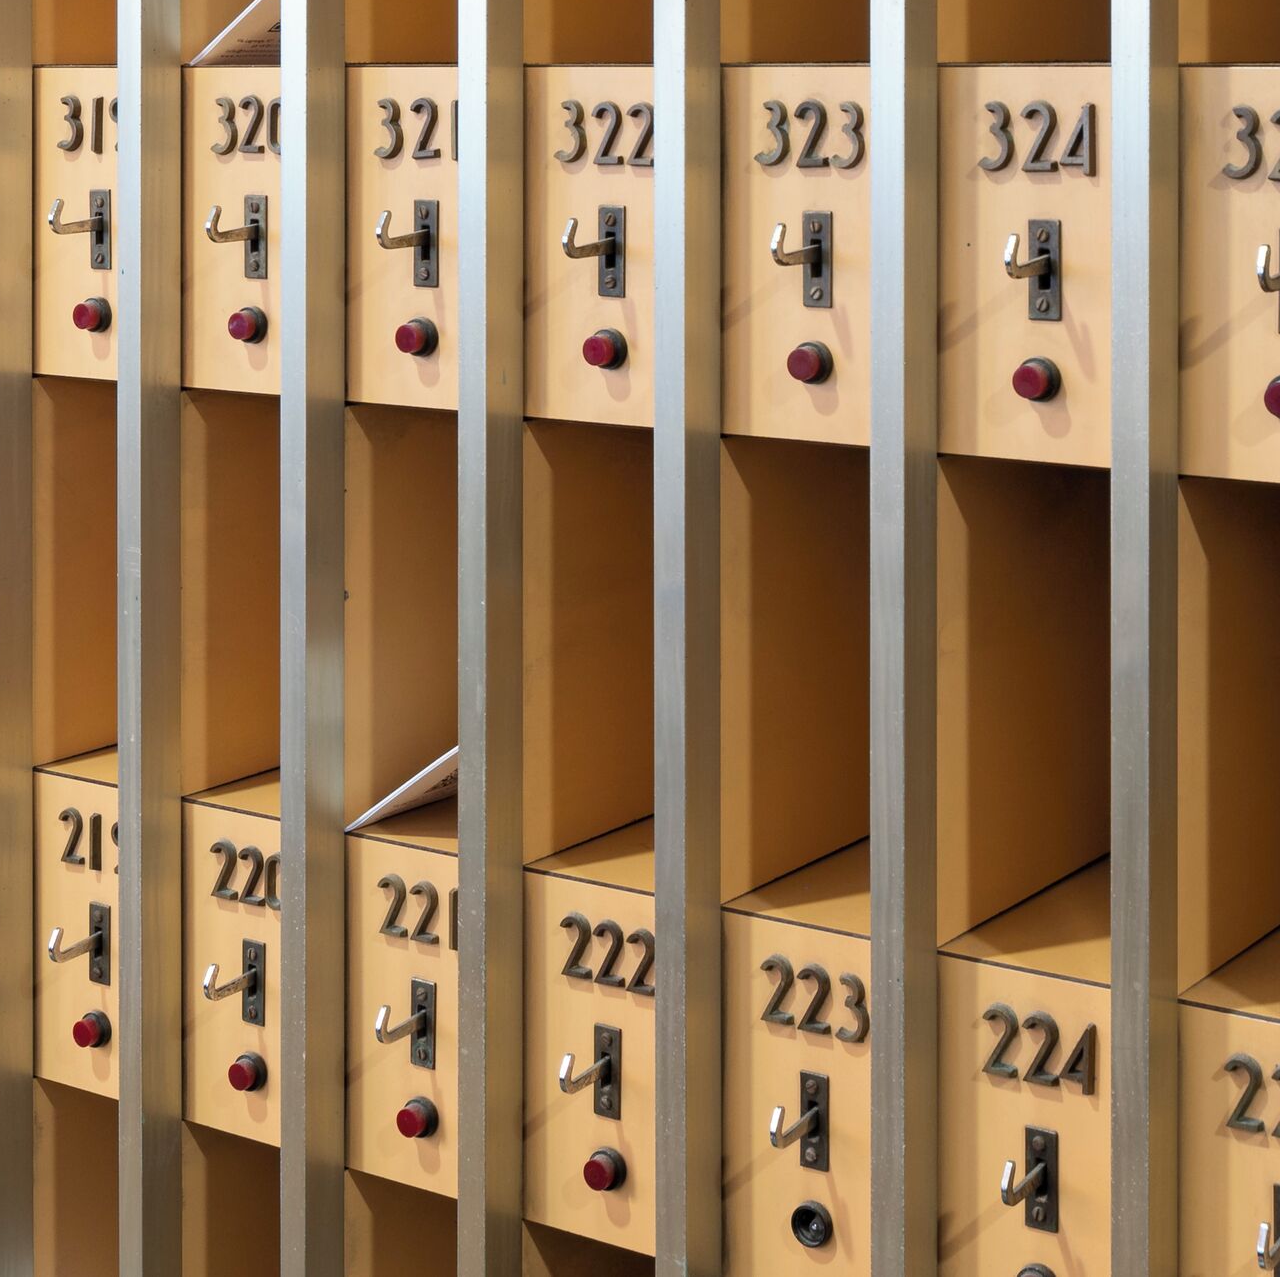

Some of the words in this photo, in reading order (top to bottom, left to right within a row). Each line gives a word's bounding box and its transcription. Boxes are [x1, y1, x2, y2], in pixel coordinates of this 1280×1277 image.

[553, 99, 654, 165] 322
[754, 99, 865, 170] 323
[978, 100, 1096, 177] 324
[560, 911, 655, 996] 222
[760, 953, 870, 1043] 223
[981, 1002, 1097, 1096] 224
